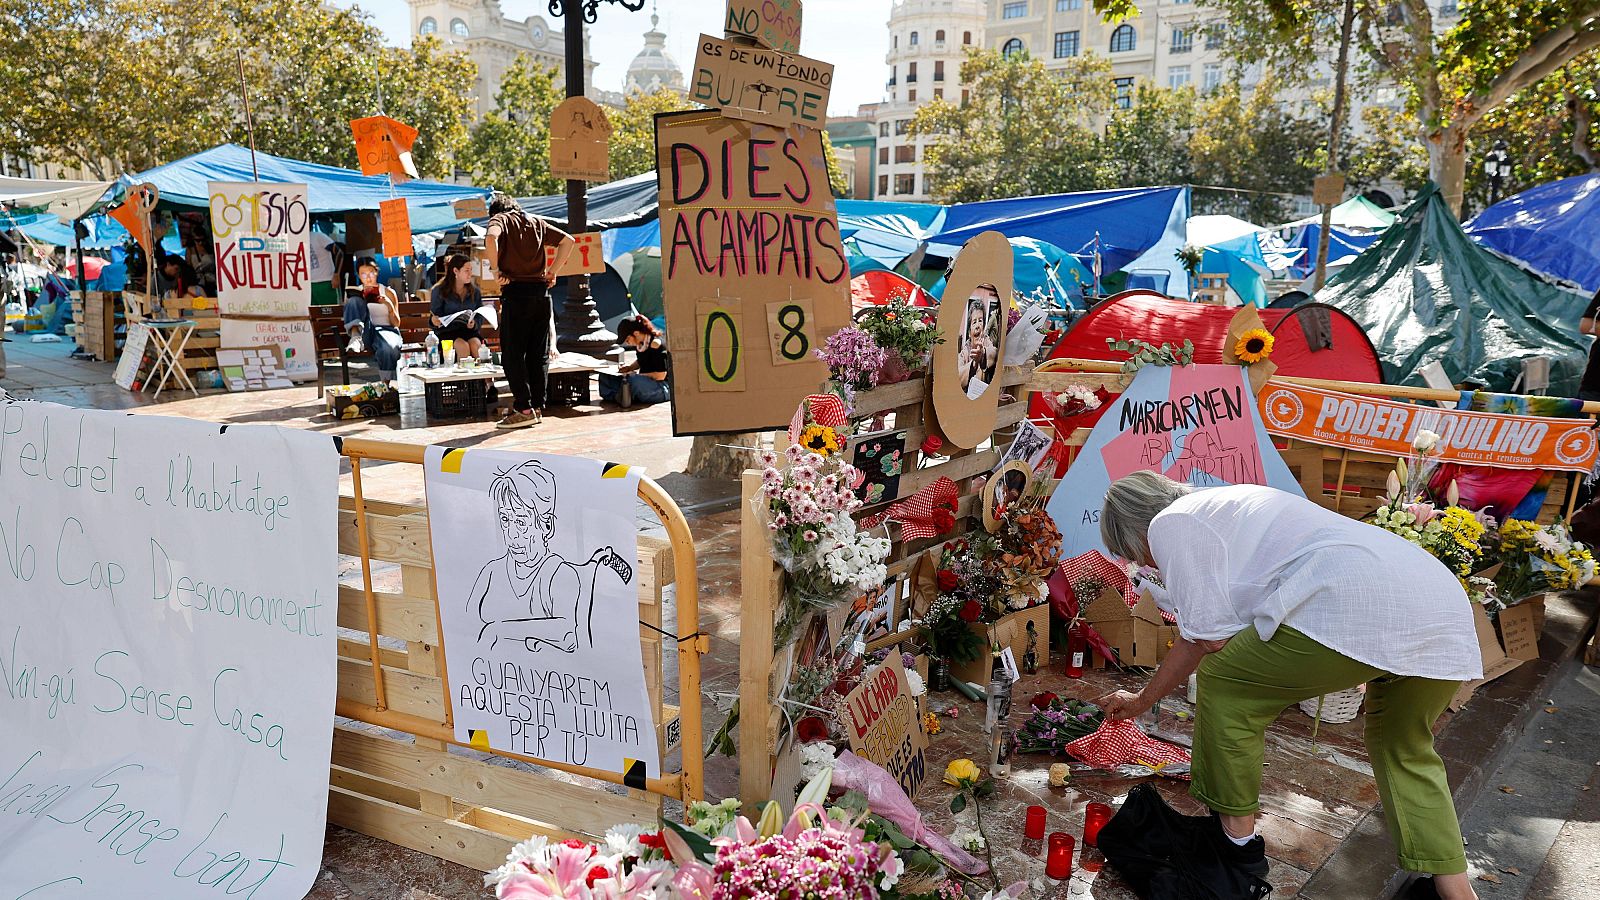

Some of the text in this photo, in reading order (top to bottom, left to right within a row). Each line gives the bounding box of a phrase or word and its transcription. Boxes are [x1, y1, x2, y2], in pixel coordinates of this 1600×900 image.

[728, 6, 759, 34] NO
[702, 42, 722, 57] es
[729, 49, 749, 64] DE
[753, 54, 775, 69] UN
[671, 138, 812, 206] DIES
[215, 241, 309, 292] KULTURA
[668, 207, 849, 285] ACAMPATS
[703, 304, 809, 384] 0 8
[1119, 385, 1242, 436] MARICARMEN
[1313, 428, 1337, 441] bloque
[1349, 435, 1375, 446] bloque
[1315, 396, 1409, 441] PODER
[1404, 410, 1549, 455] INQUILINO
[1140, 427, 1238, 466] ABASCAL
[1456, 451, 1533, 464] contra el rentismo
[135, 486, 151, 506] a
[166, 453, 290, 531] l'habitatge
[1082, 509, 1101, 526] AS
[56, 516, 125, 608] Cap
[150, 536, 323, 637] Desnonament
[93, 650, 194, 727] Sense
[213, 668, 288, 761] Casa
[471, 656, 612, 710] GUANYAREM
[847, 666, 898, 739] LUCHAD
[460, 684, 639, 746] AQUESTA LLUITA
[510, 719, 588, 766] PER TÚ
[46, 763, 179, 864] Sense
